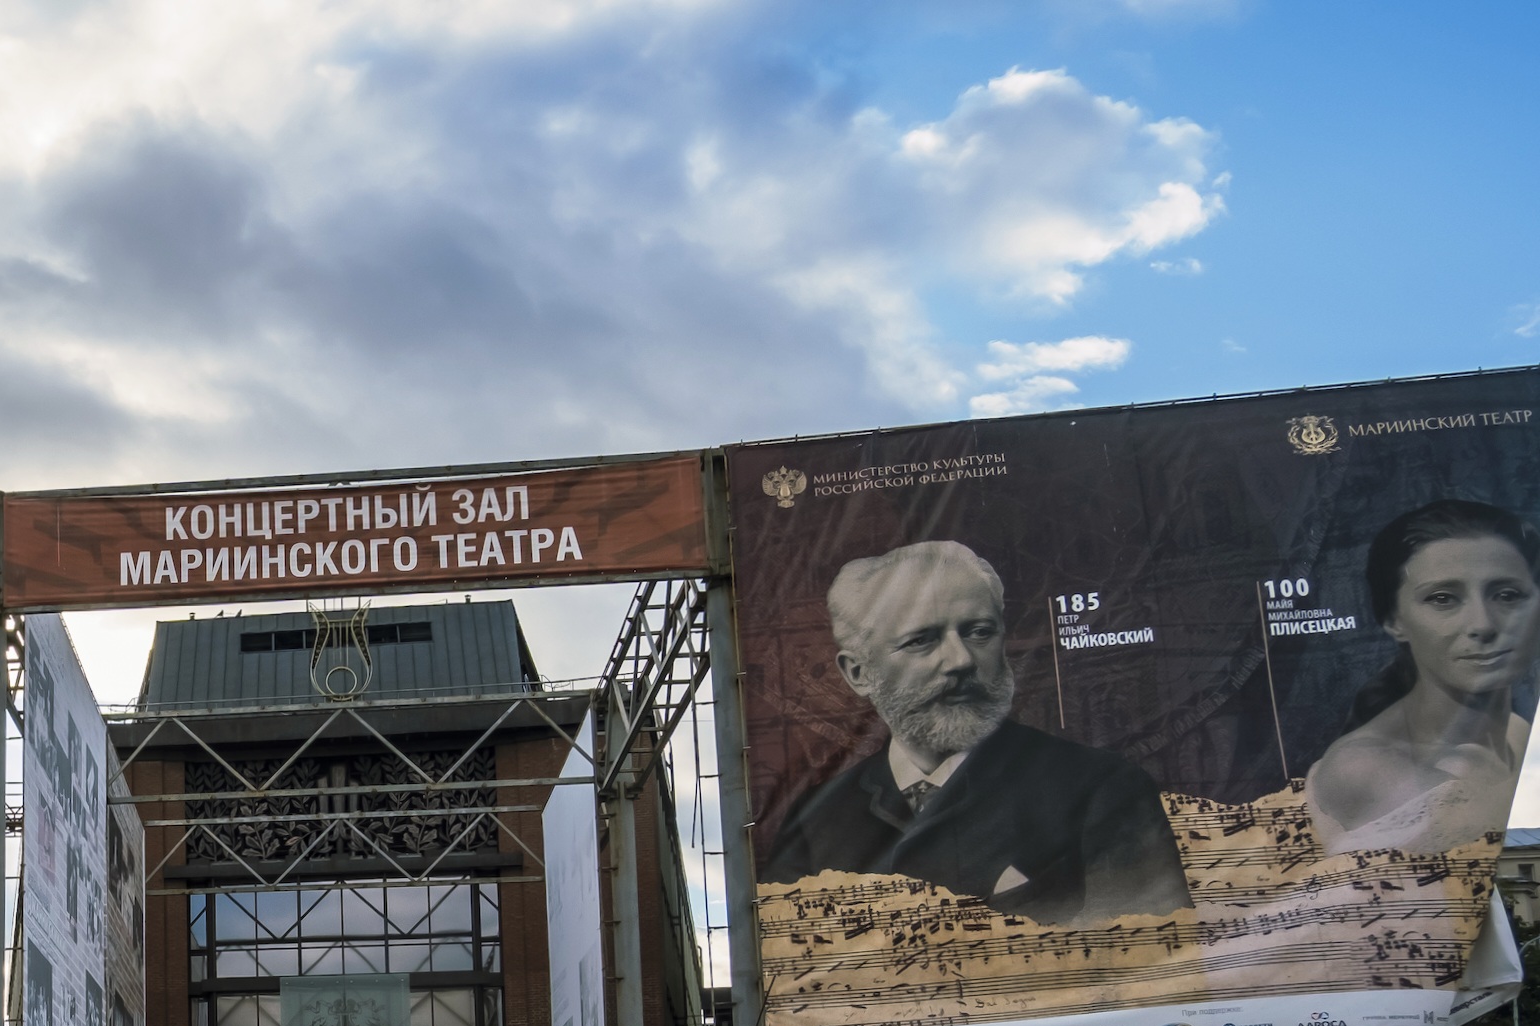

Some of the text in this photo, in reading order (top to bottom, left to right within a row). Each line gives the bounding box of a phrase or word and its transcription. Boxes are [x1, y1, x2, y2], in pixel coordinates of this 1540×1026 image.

[1348, 409, 1533, 437] МАРИИНСКИЙ ТЕАТР
[813, 453, 1006, 484] МИНИСТЕРСТВО КУЛЬТУРЫ
[814, 466, 1008, 497] РОССИЙСКОЙ ФЕДЕРАЦИИ
[165, 484, 530, 541] КОНЦЕРТНЫЙ ЗАЛ
[119, 526, 583, 586] МАРИИНСКОГО ТЕАТРА
[1264, 578, 1309, 598] 100
[1055, 592, 1100, 613] 185
[1266, 599, 1294, 610] МАЙЯ
[1057, 614, 1079, 624] ПЕТР
[1268, 608, 1333, 621] МИХАЙЛОВНА
[1058, 624, 1089, 635] ИЛЬИЧ
[1269, 616, 1356, 636] ПЛИСЕЦКАЯ
[1060, 627, 1154, 650] ЧАЙКОВСКИЙ
